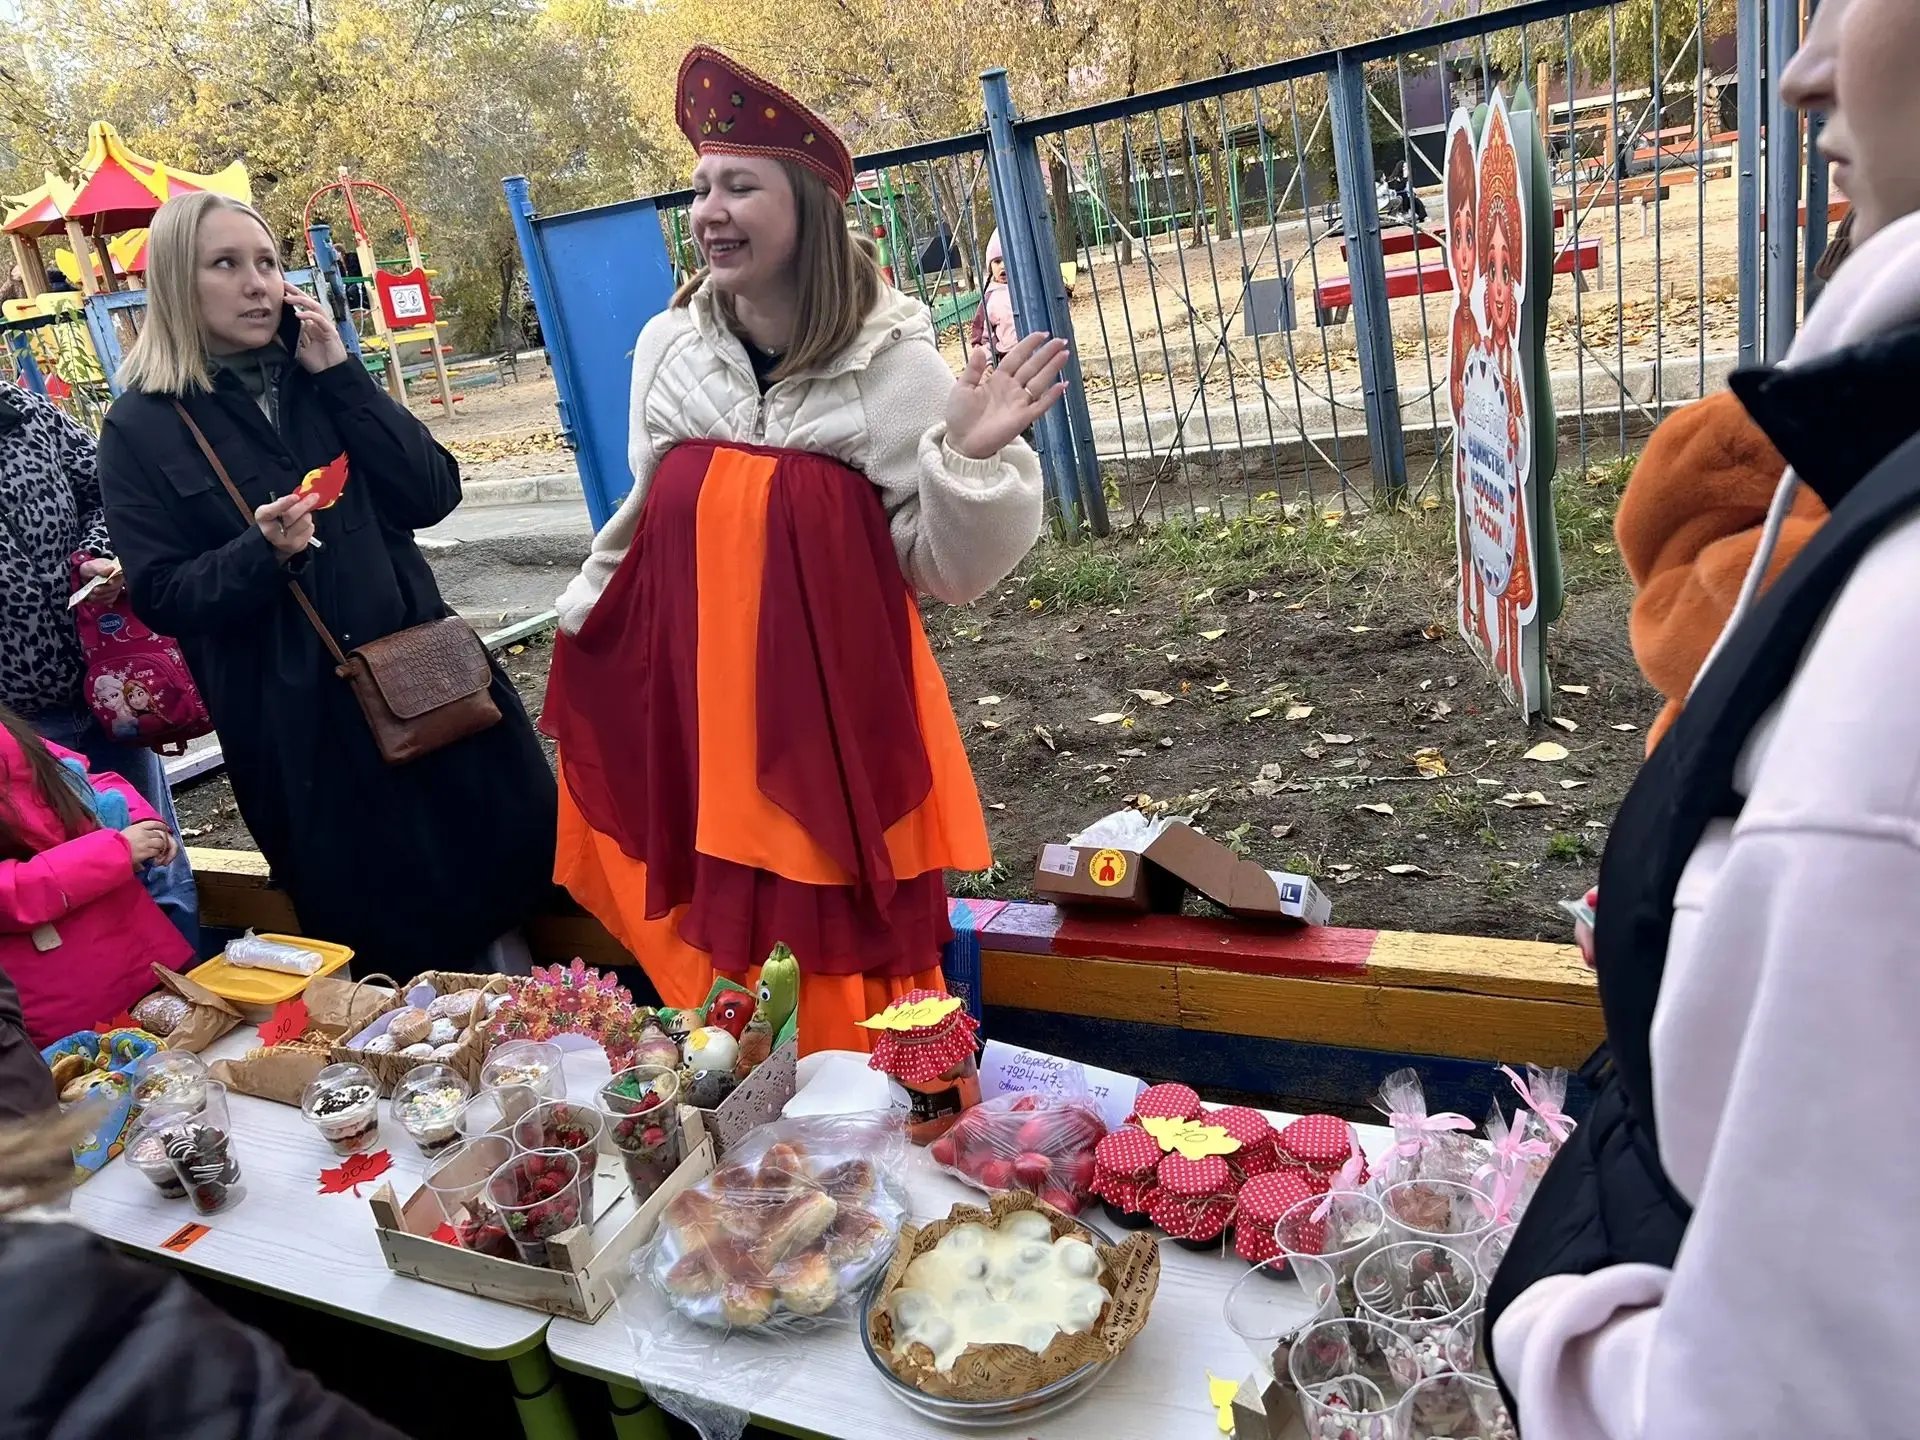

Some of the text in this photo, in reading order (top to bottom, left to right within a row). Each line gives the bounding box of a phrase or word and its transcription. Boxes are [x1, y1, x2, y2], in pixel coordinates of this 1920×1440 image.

[1470, 468, 1505, 514] народов
[134, 669, 154, 680] LOVE
[1121, 1266, 1136, 1292] very
